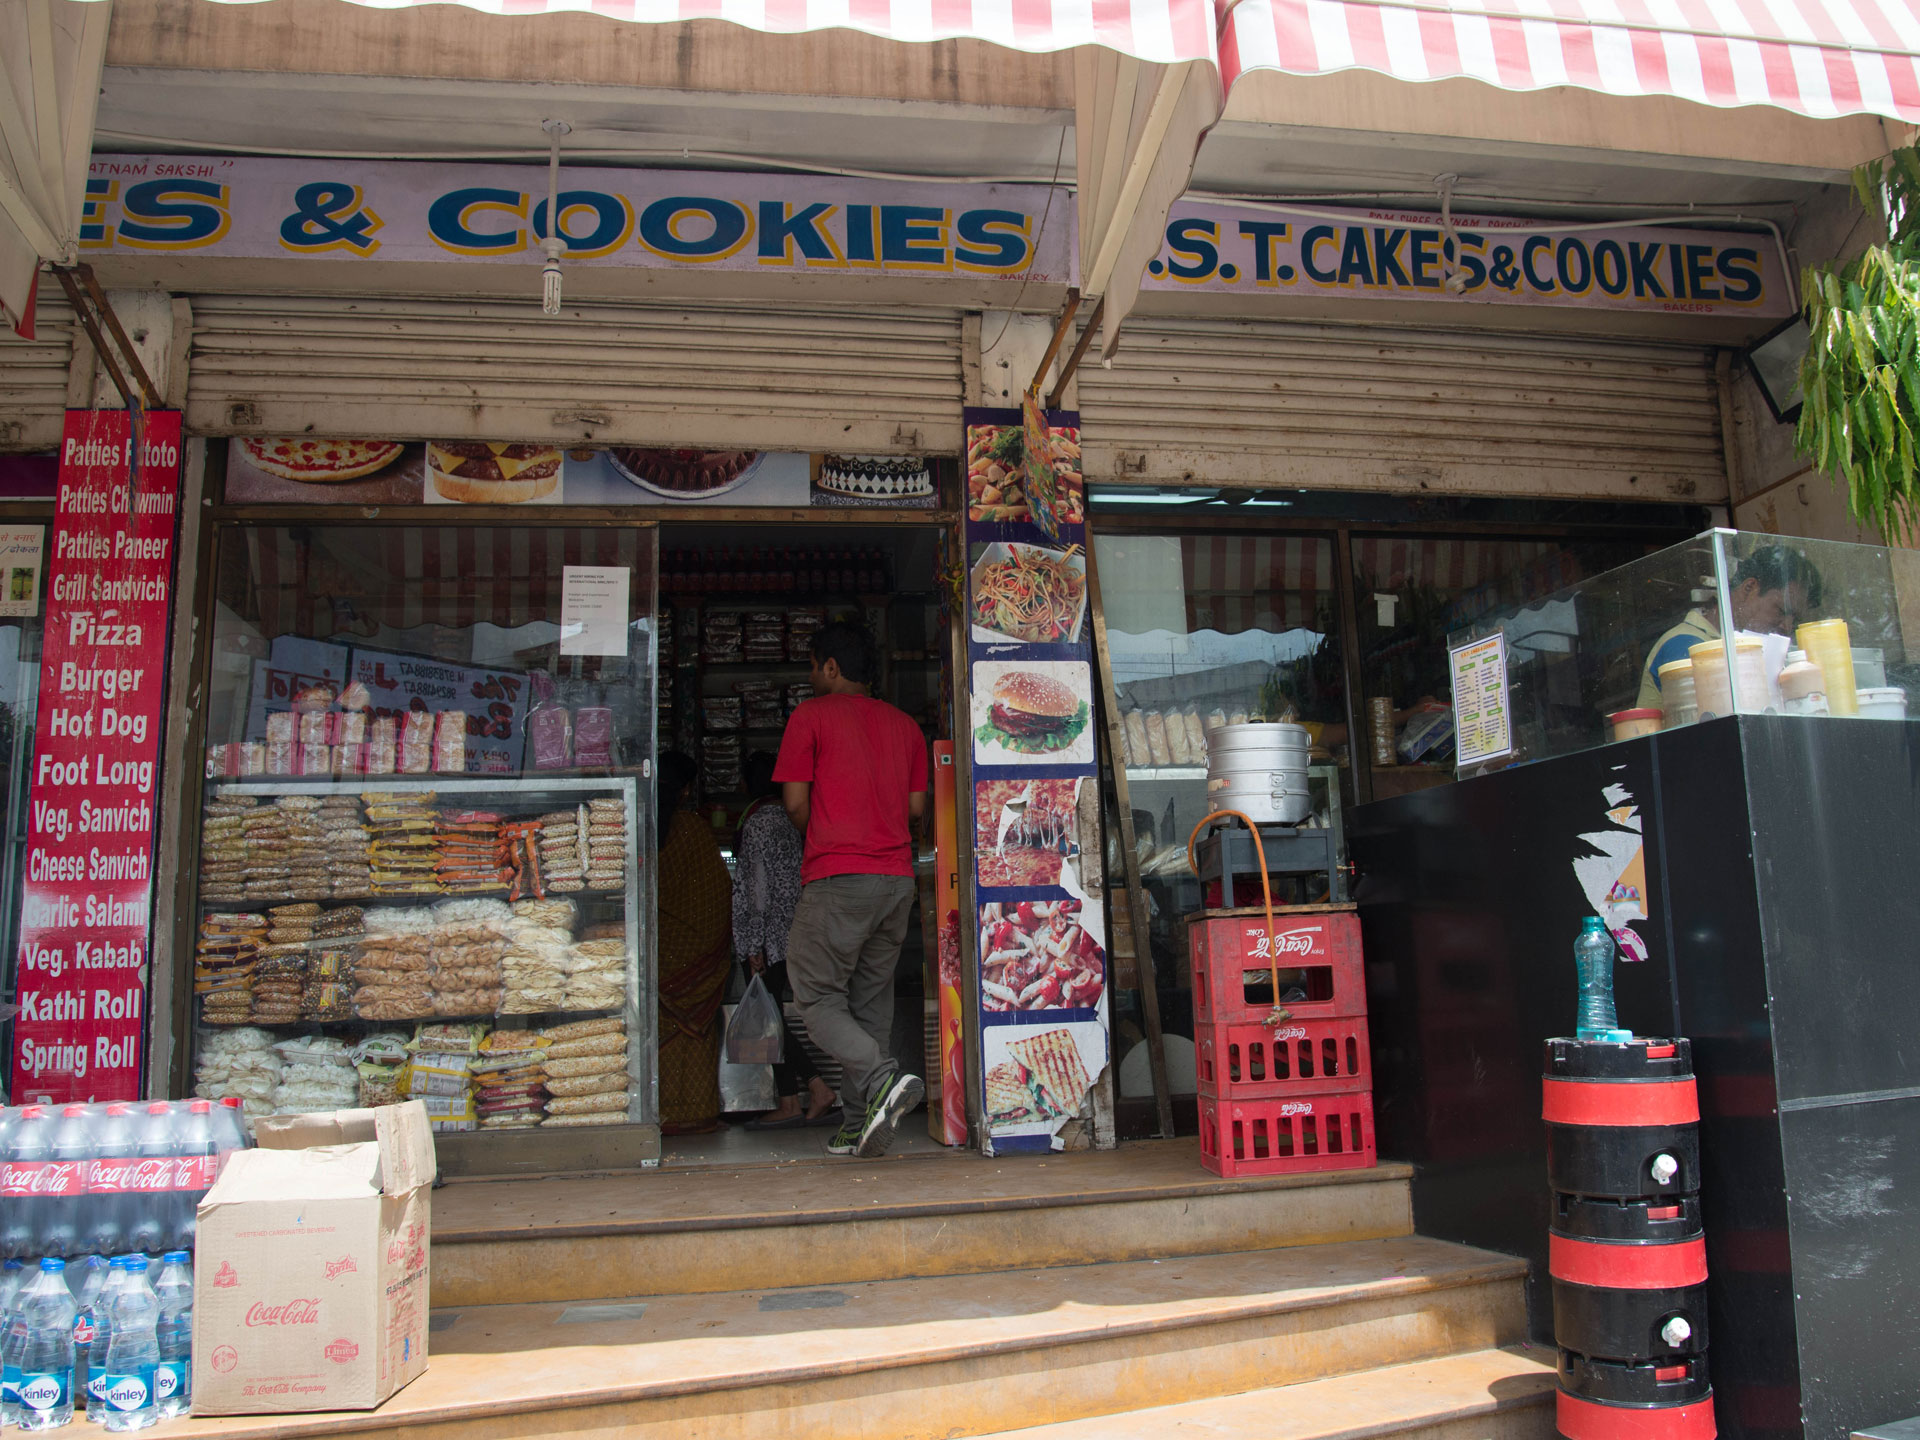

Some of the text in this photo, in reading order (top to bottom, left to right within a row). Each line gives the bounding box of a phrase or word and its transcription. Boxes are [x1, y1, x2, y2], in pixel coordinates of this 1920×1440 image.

[279, 182, 384, 257] &
[428, 187, 1034, 275] COOKIES
[1664, 303, 1713, 313] BAKERS
[64, 437, 177, 468] Patties Ptoto
[60, 484, 174, 514] Patties Chwmin
[57, 530, 169, 560] Patties Paneer
[53, 572, 165, 601] Grill Sandvich
[68, 617, 142, 646] Pizza
[60, 661, 144, 699] Burger
[50, 708, 148, 743] Hot Dog
[38, 754, 152, 793] Foot Long
[34, 799, 150, 842] Veg. Sanvich
[30, 846, 148, 882] Cheese Sanvich
[26, 894, 146, 928] Garlic Salami
[24, 940, 142, 977] Veg. Kabab
[21, 989, 140, 1022] Kathi Roll
[20, 1036, 136, 1078] Spring Roll
[245, 1298, 323, 1327] Coca-Cola
[24, 1386, 59, 1402] kinley
[110, 1387, 146, 1402] kinley
